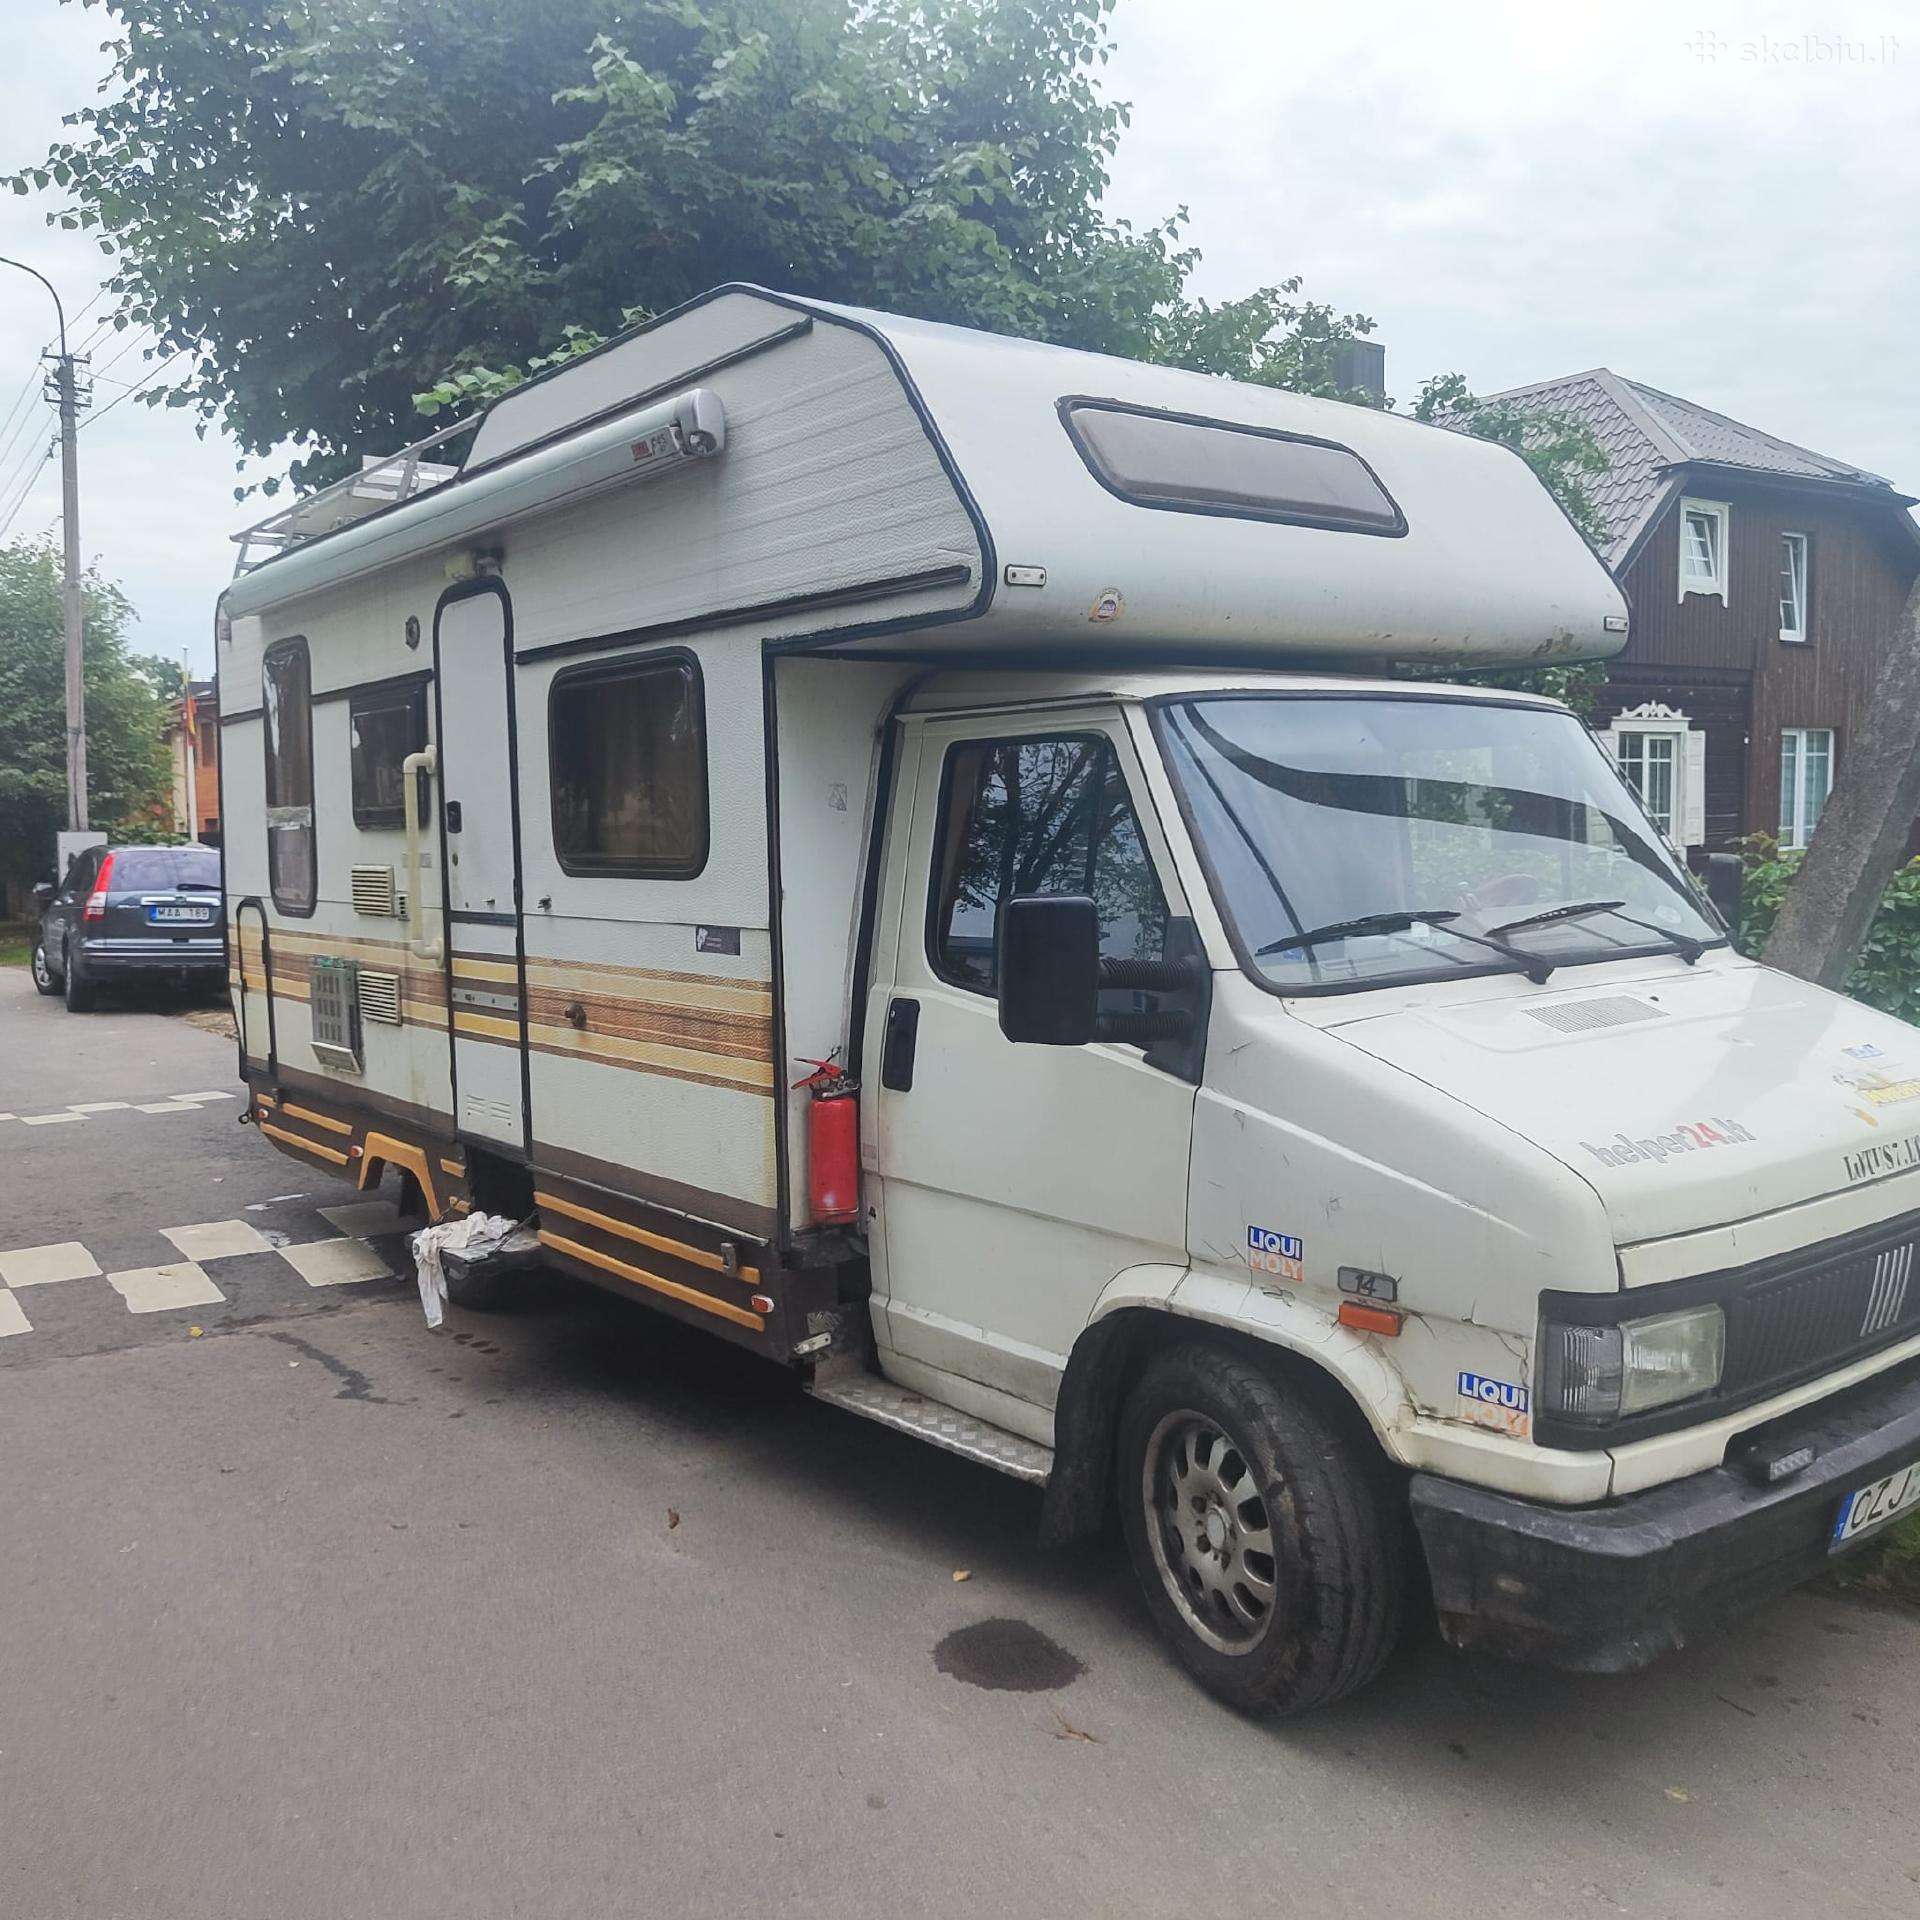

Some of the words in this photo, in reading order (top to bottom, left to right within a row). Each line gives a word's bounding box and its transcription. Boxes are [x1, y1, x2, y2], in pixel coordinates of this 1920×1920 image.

[1578, 1117, 1757, 1168] helper24.lt
[1249, 1227, 1301, 1259] LIQUI
[1356, 1273, 1376, 1296] 14
[1461, 1373, 1526, 1411] LIQUI
[1850, 1469, 1913, 1529] CZJ
